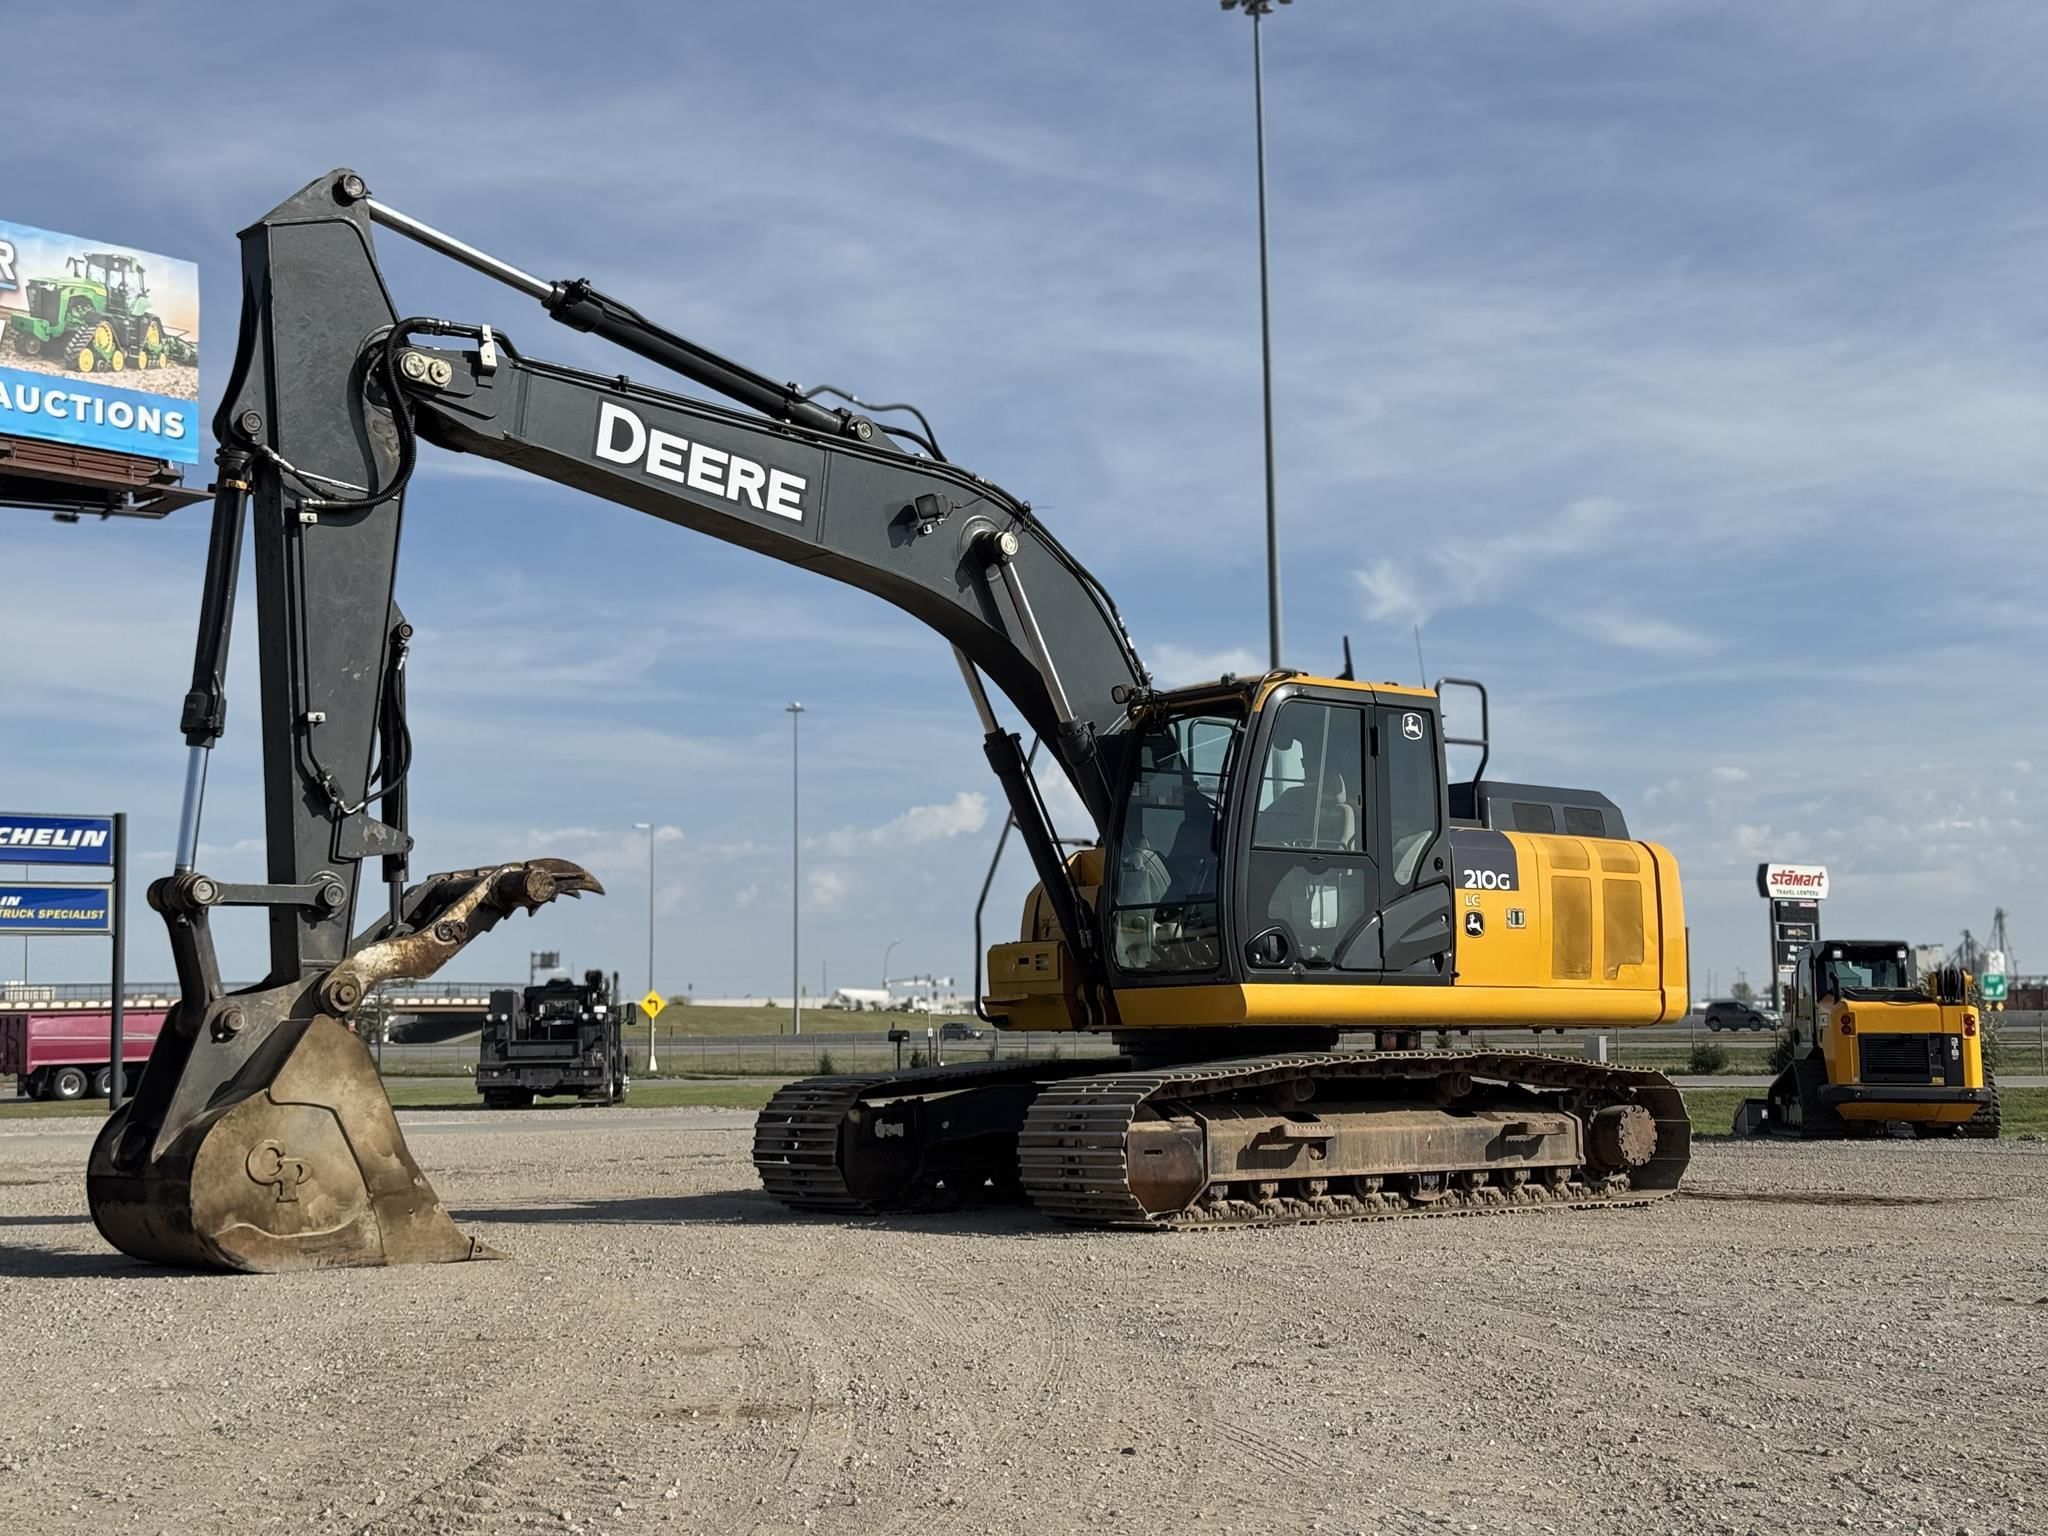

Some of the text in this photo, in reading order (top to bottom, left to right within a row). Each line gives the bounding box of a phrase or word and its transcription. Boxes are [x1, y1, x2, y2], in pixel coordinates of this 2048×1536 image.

[595, 401, 808, 522] DEERE
[1463, 869, 1510, 890] 210G
[1465, 894, 1480, 907] LC
[38, 909, 105, 920] SPECIALIST
